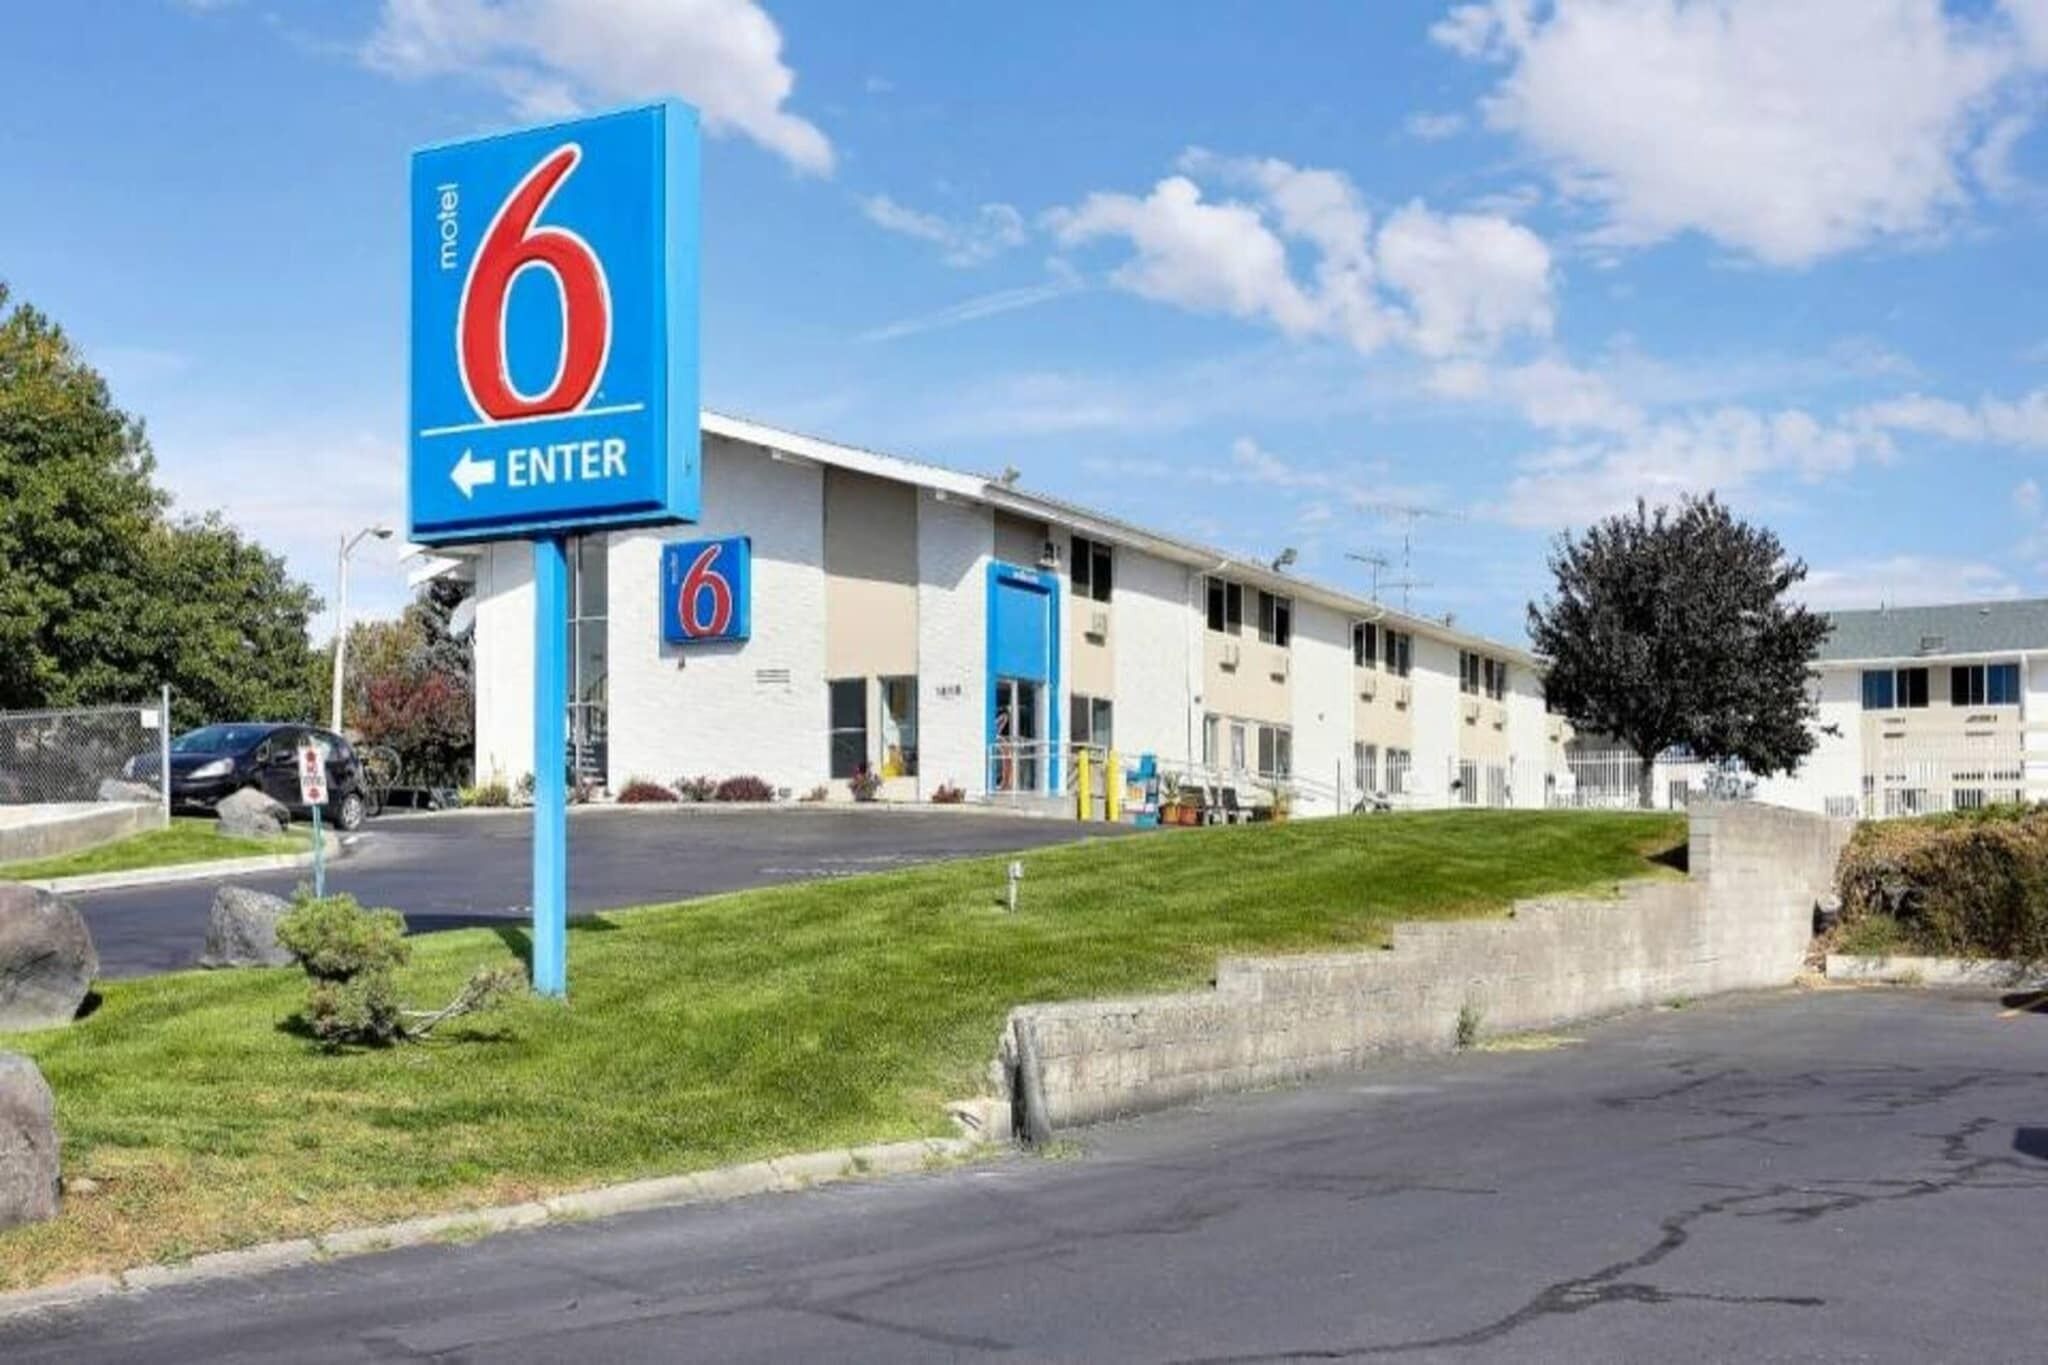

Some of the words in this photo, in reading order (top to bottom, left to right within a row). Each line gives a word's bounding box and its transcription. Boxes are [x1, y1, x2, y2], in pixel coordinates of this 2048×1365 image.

[437, 182, 459, 270] motel
[456, 142, 613, 427] 6
[507, 438, 628, 488] ENTER
[678, 543, 733, 638] 6
